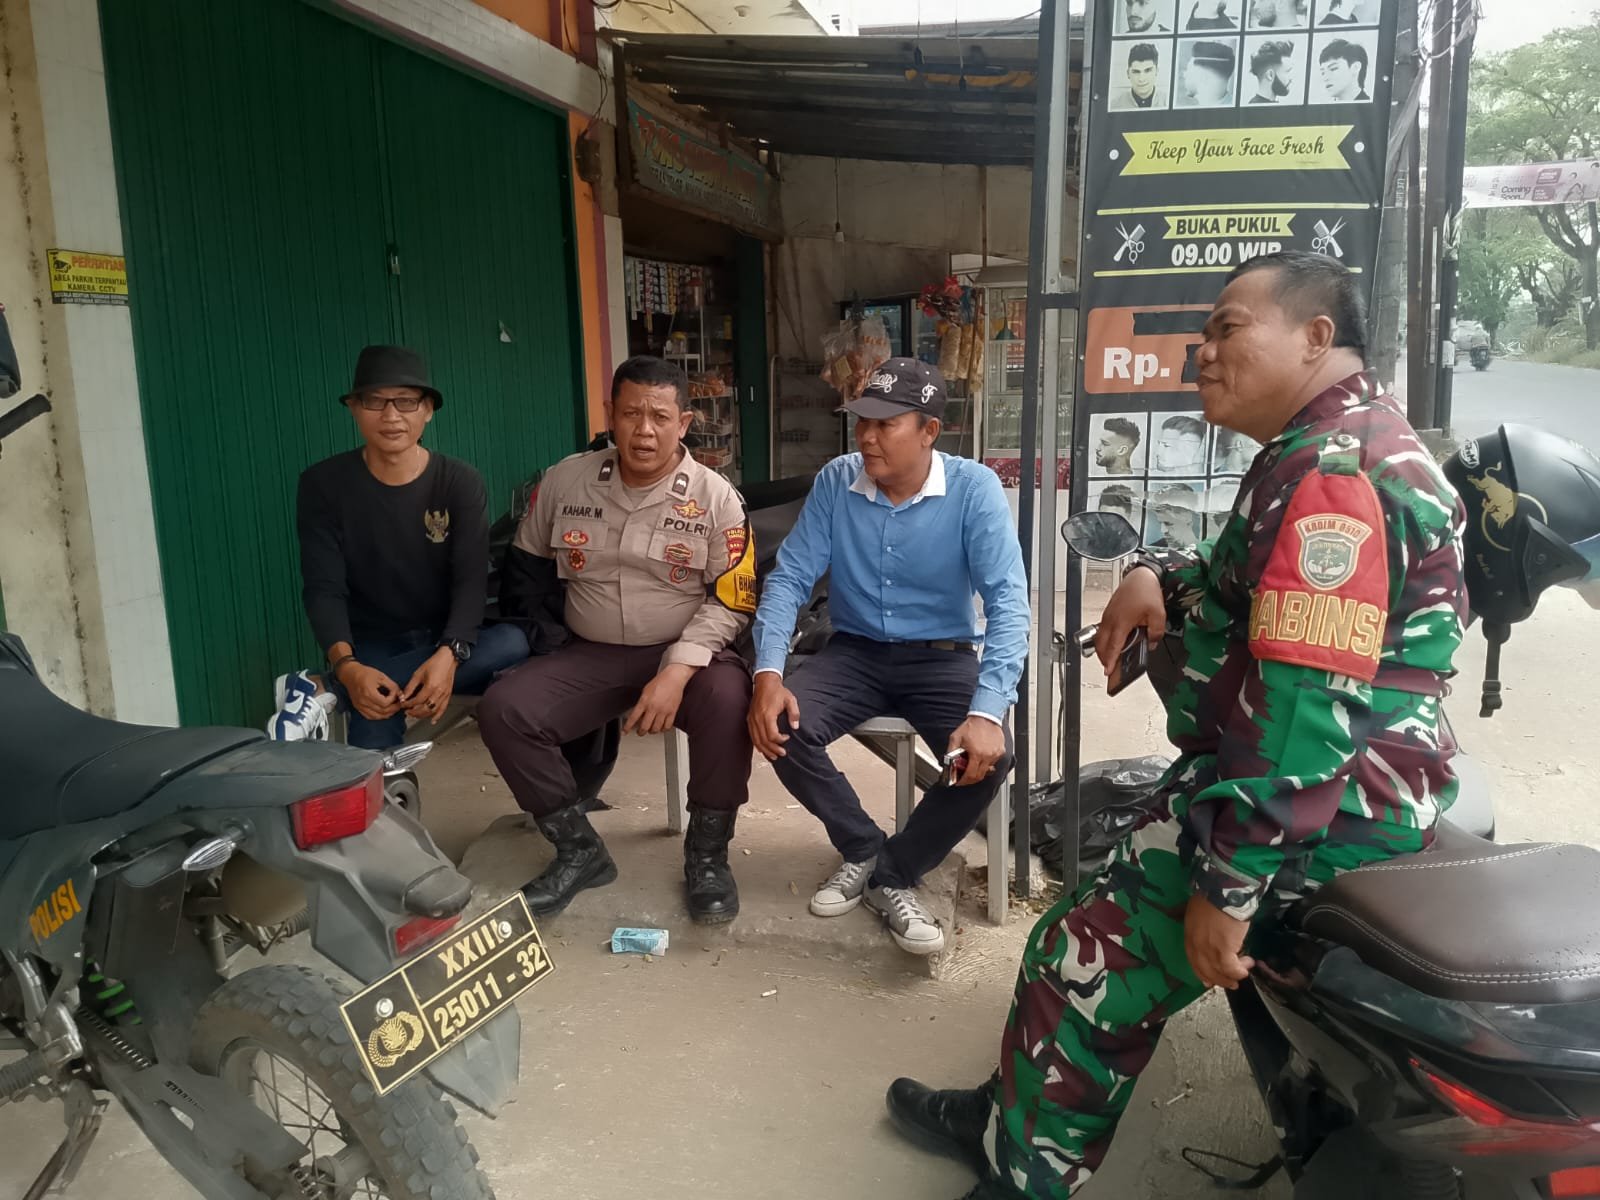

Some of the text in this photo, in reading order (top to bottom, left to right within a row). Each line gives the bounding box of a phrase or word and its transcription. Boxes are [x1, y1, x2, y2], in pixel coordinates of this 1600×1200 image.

[1147, 135, 1325, 164] Keep Your Face Fresh
[1501, 185, 1531, 196] Coming
[1176, 217, 1281, 235] BUKA PUKUL
[1171, 242, 1232, 266] 09.00
[67, 283, 116, 293] KAMERA CCTV
[72, 275, 93, 283] PARKIR
[1103, 347, 1170, 385] Rp.
[663, 517, 708, 536] POLRI
[1305, 520, 1336, 534] KODIM
[28, 879, 82, 946] POLISI
[437, 919, 505, 979] XXIII
[433, 972, 503, 1039] 25011
[516, 942, 547, 978] 32
